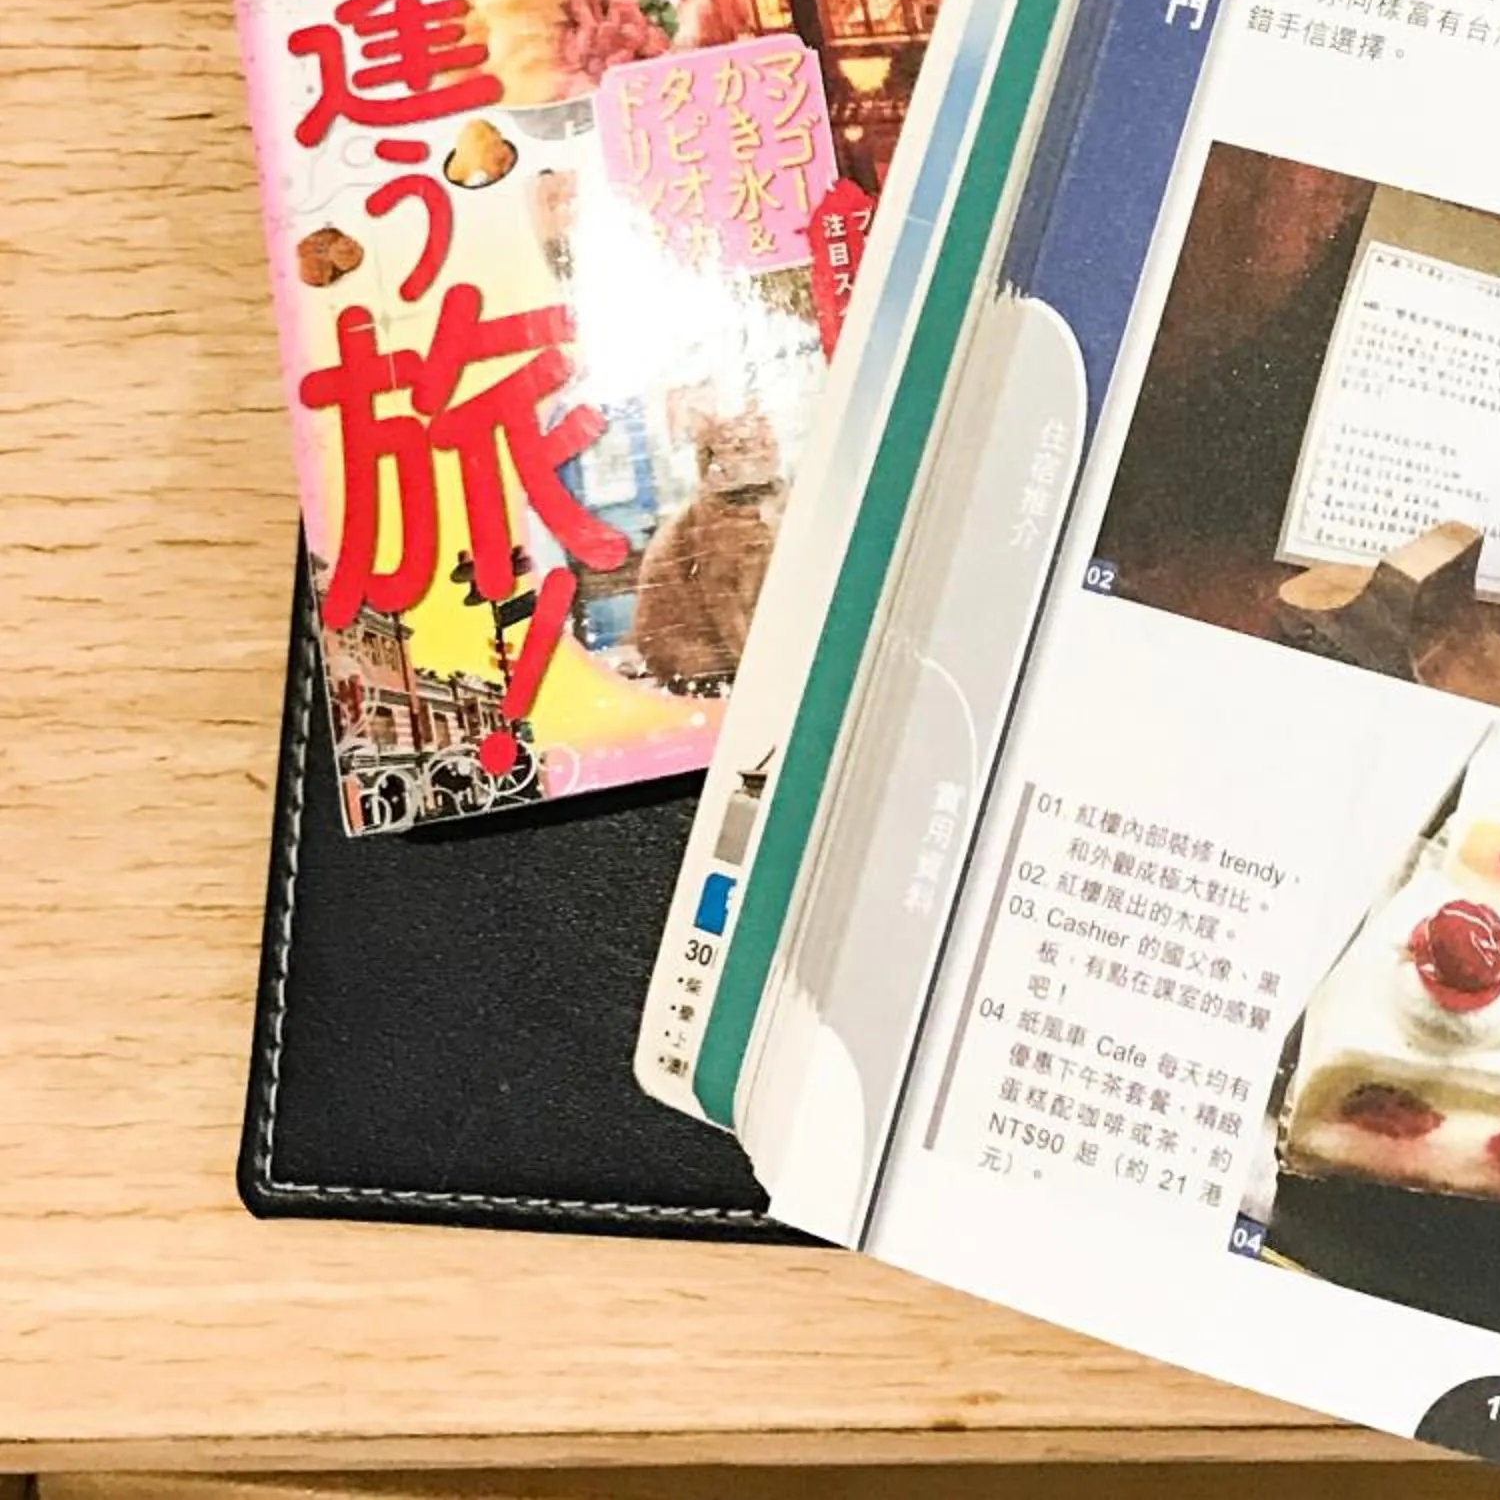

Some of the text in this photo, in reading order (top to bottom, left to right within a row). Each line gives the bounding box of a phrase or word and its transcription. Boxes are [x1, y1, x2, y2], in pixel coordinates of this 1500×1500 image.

[756, 50, 822, 213] マンゴー
[1086, 565, 1116, 591] 02
[1047, 906, 1131, 950] Cashier
[1096, 1034, 1147, 1070] Cafe
[987, 1112, 1065, 1156] NT$90
[1158, 1167, 1188, 1195] 21
[1233, 1227, 1263, 1254] 04
